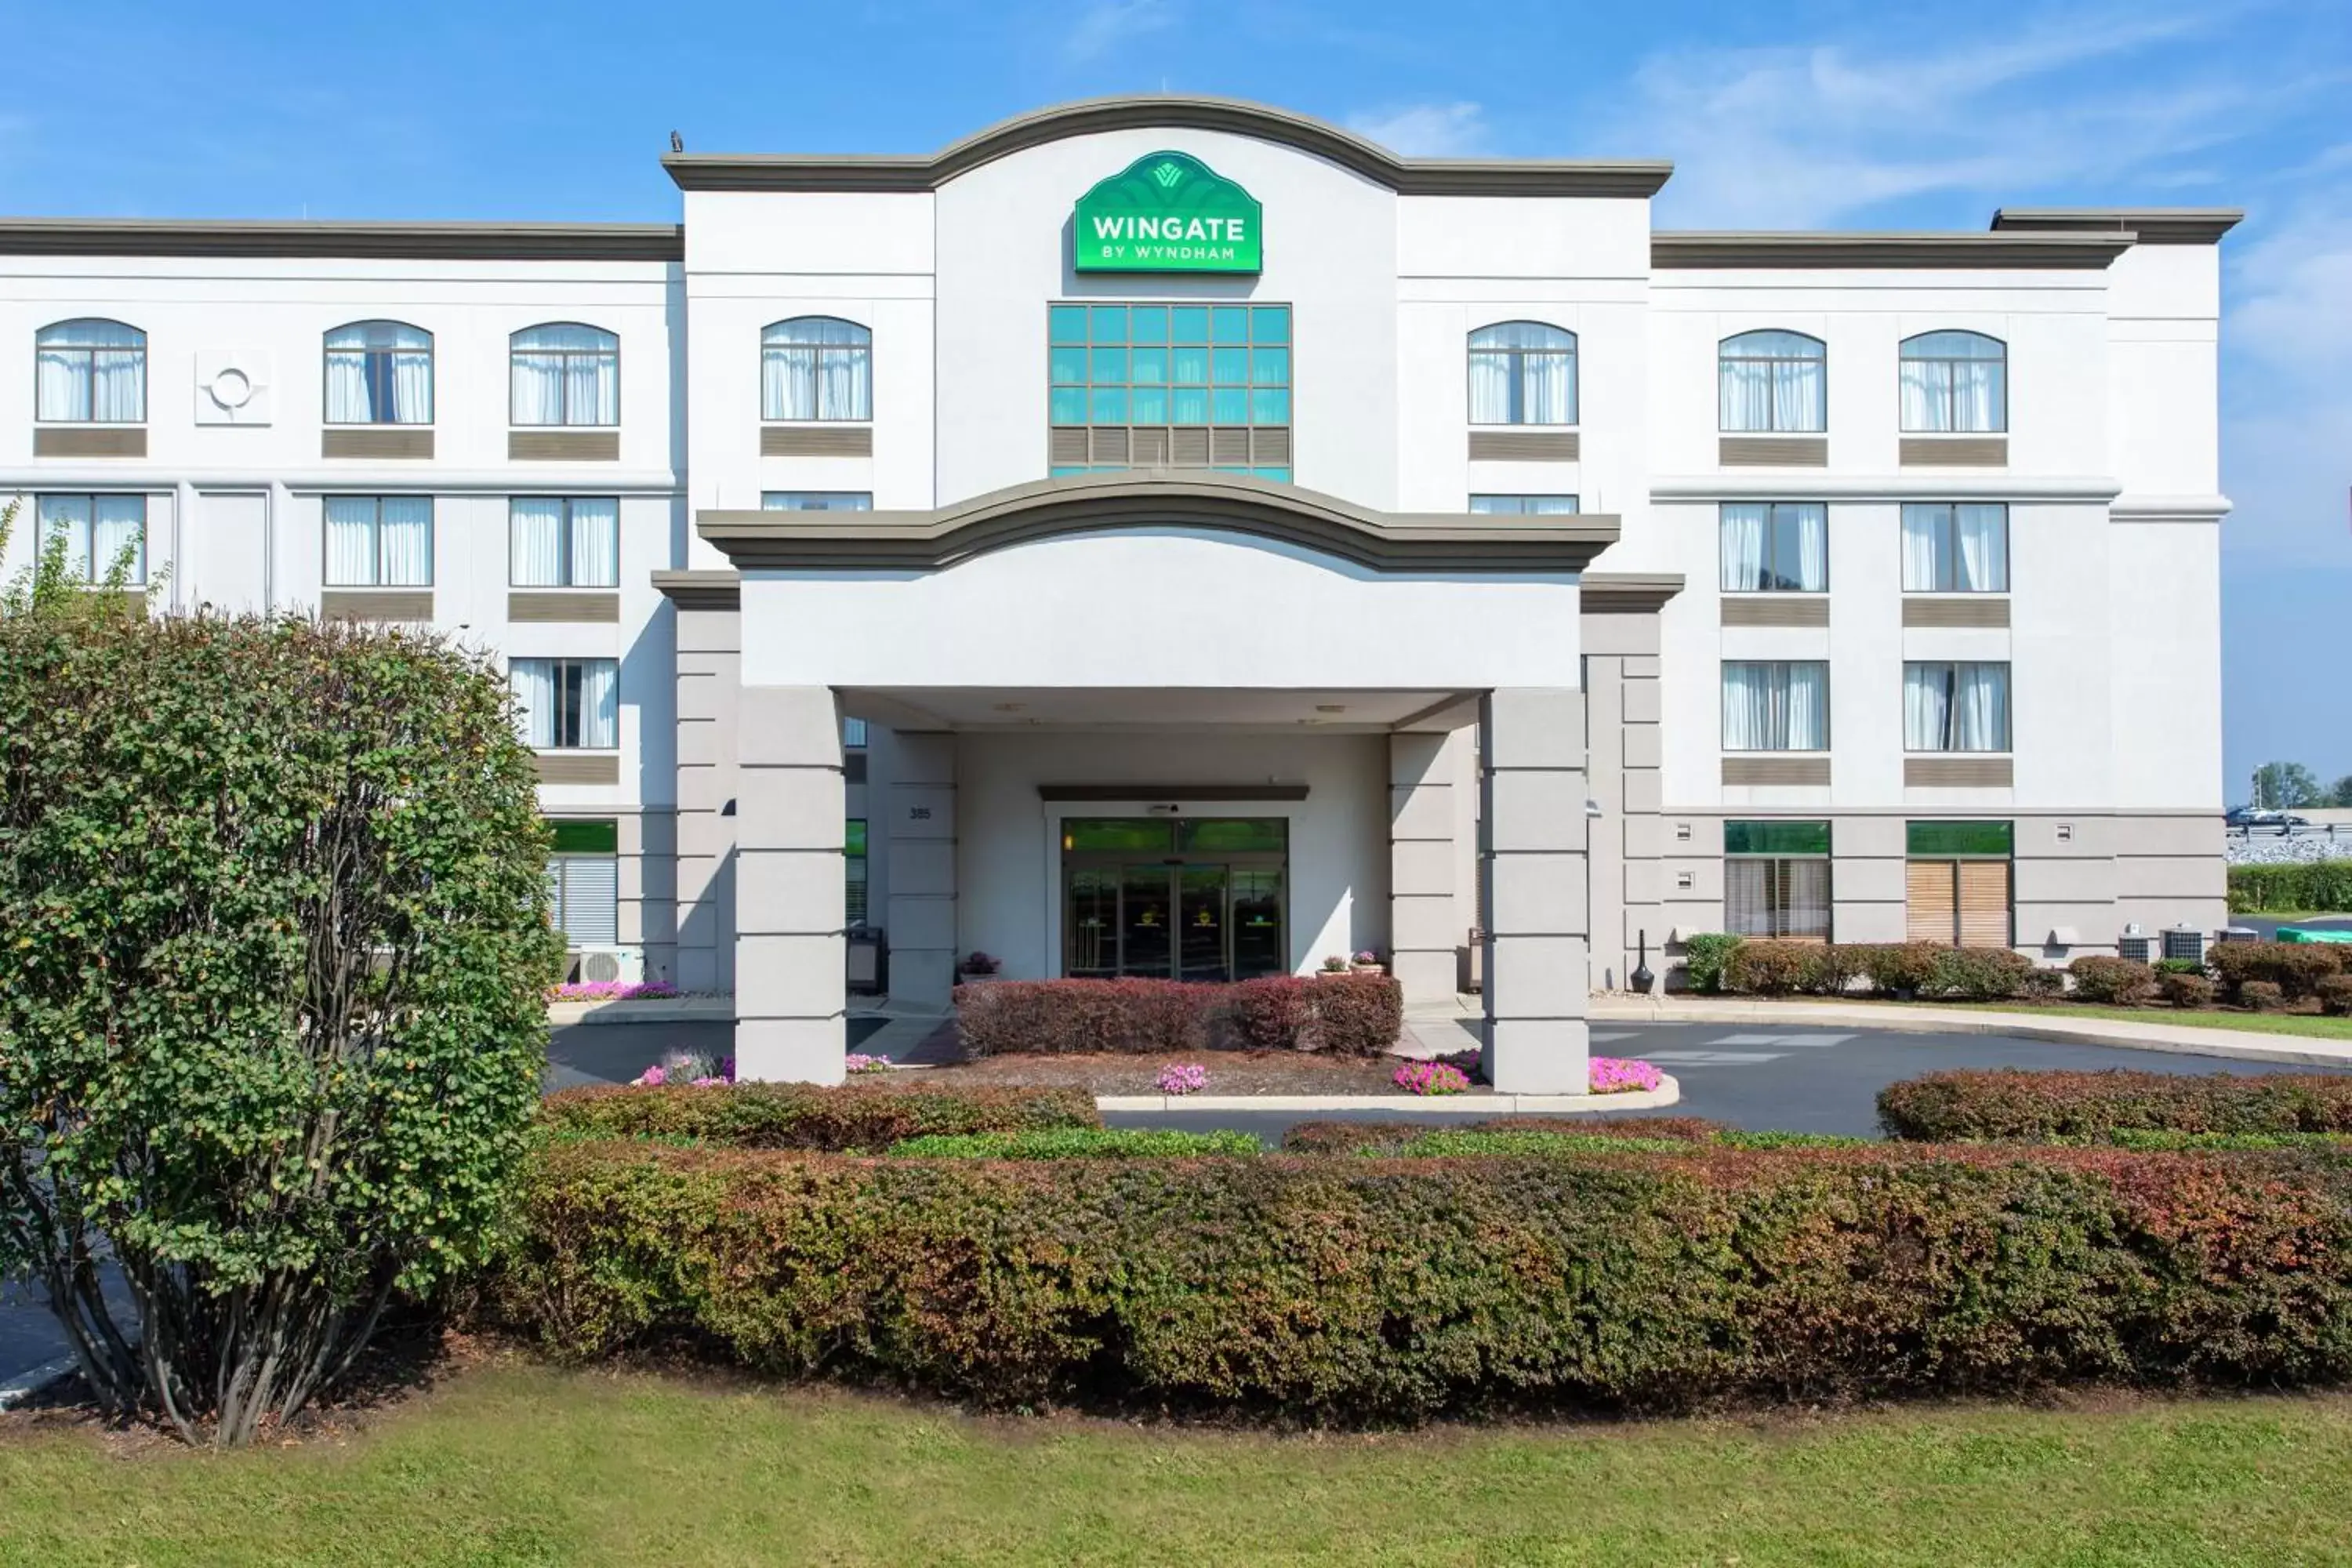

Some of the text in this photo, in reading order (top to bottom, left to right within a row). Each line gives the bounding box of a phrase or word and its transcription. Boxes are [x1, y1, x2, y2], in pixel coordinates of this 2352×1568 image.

[1093, 216, 1245, 241] WINGATE
[1102, 245, 1235, 260] BY WYNDHAM
